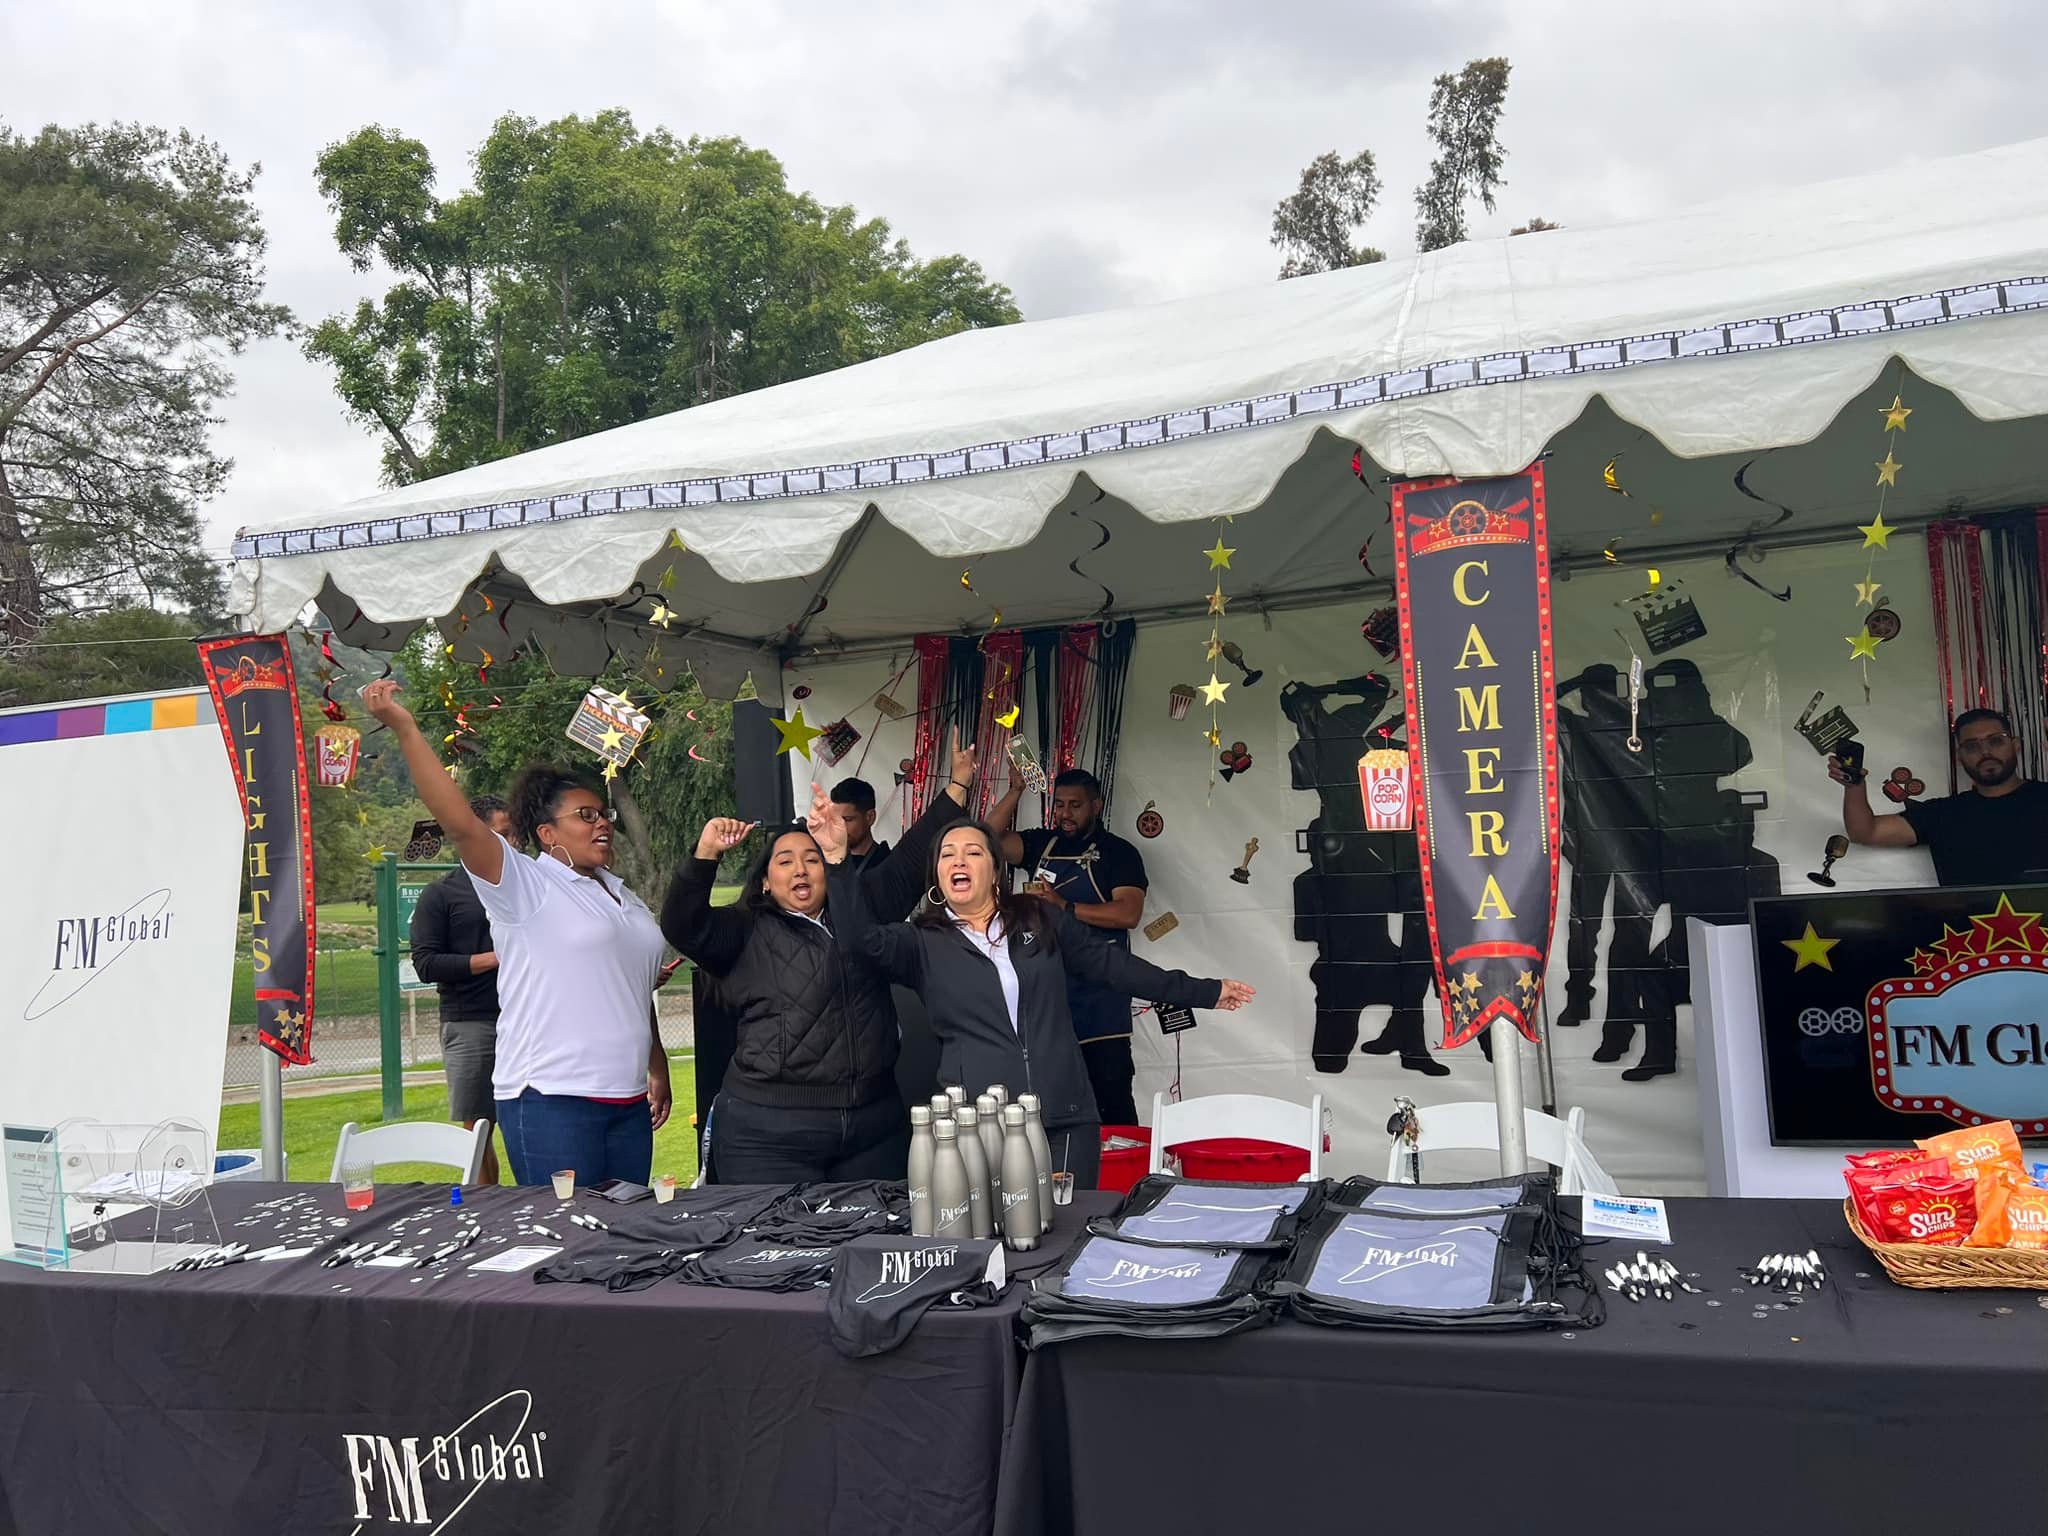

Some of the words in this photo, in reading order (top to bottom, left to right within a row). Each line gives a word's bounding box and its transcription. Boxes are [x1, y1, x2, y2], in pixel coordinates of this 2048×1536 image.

[1452, 560, 1517, 921] CAMERA
[1374, 793, 1402, 804] CORN
[1377, 784, 1399, 794] POP
[241, 700, 273, 974] LIGHTS
[53, 917, 101, 970] FM
[1890, 1024, 1976, 1068] FM
[1956, 1143, 1994, 1166] Sun
[1908, 1208, 1952, 1238] Sun
[1928, 1219, 1956, 1234] CHIPS
[879, 1251, 911, 1283] FM
[1112, 1259, 1150, 1279] FM
[1362, 1247, 1400, 1266] FM
[342, 1434, 432, 1523] FM
